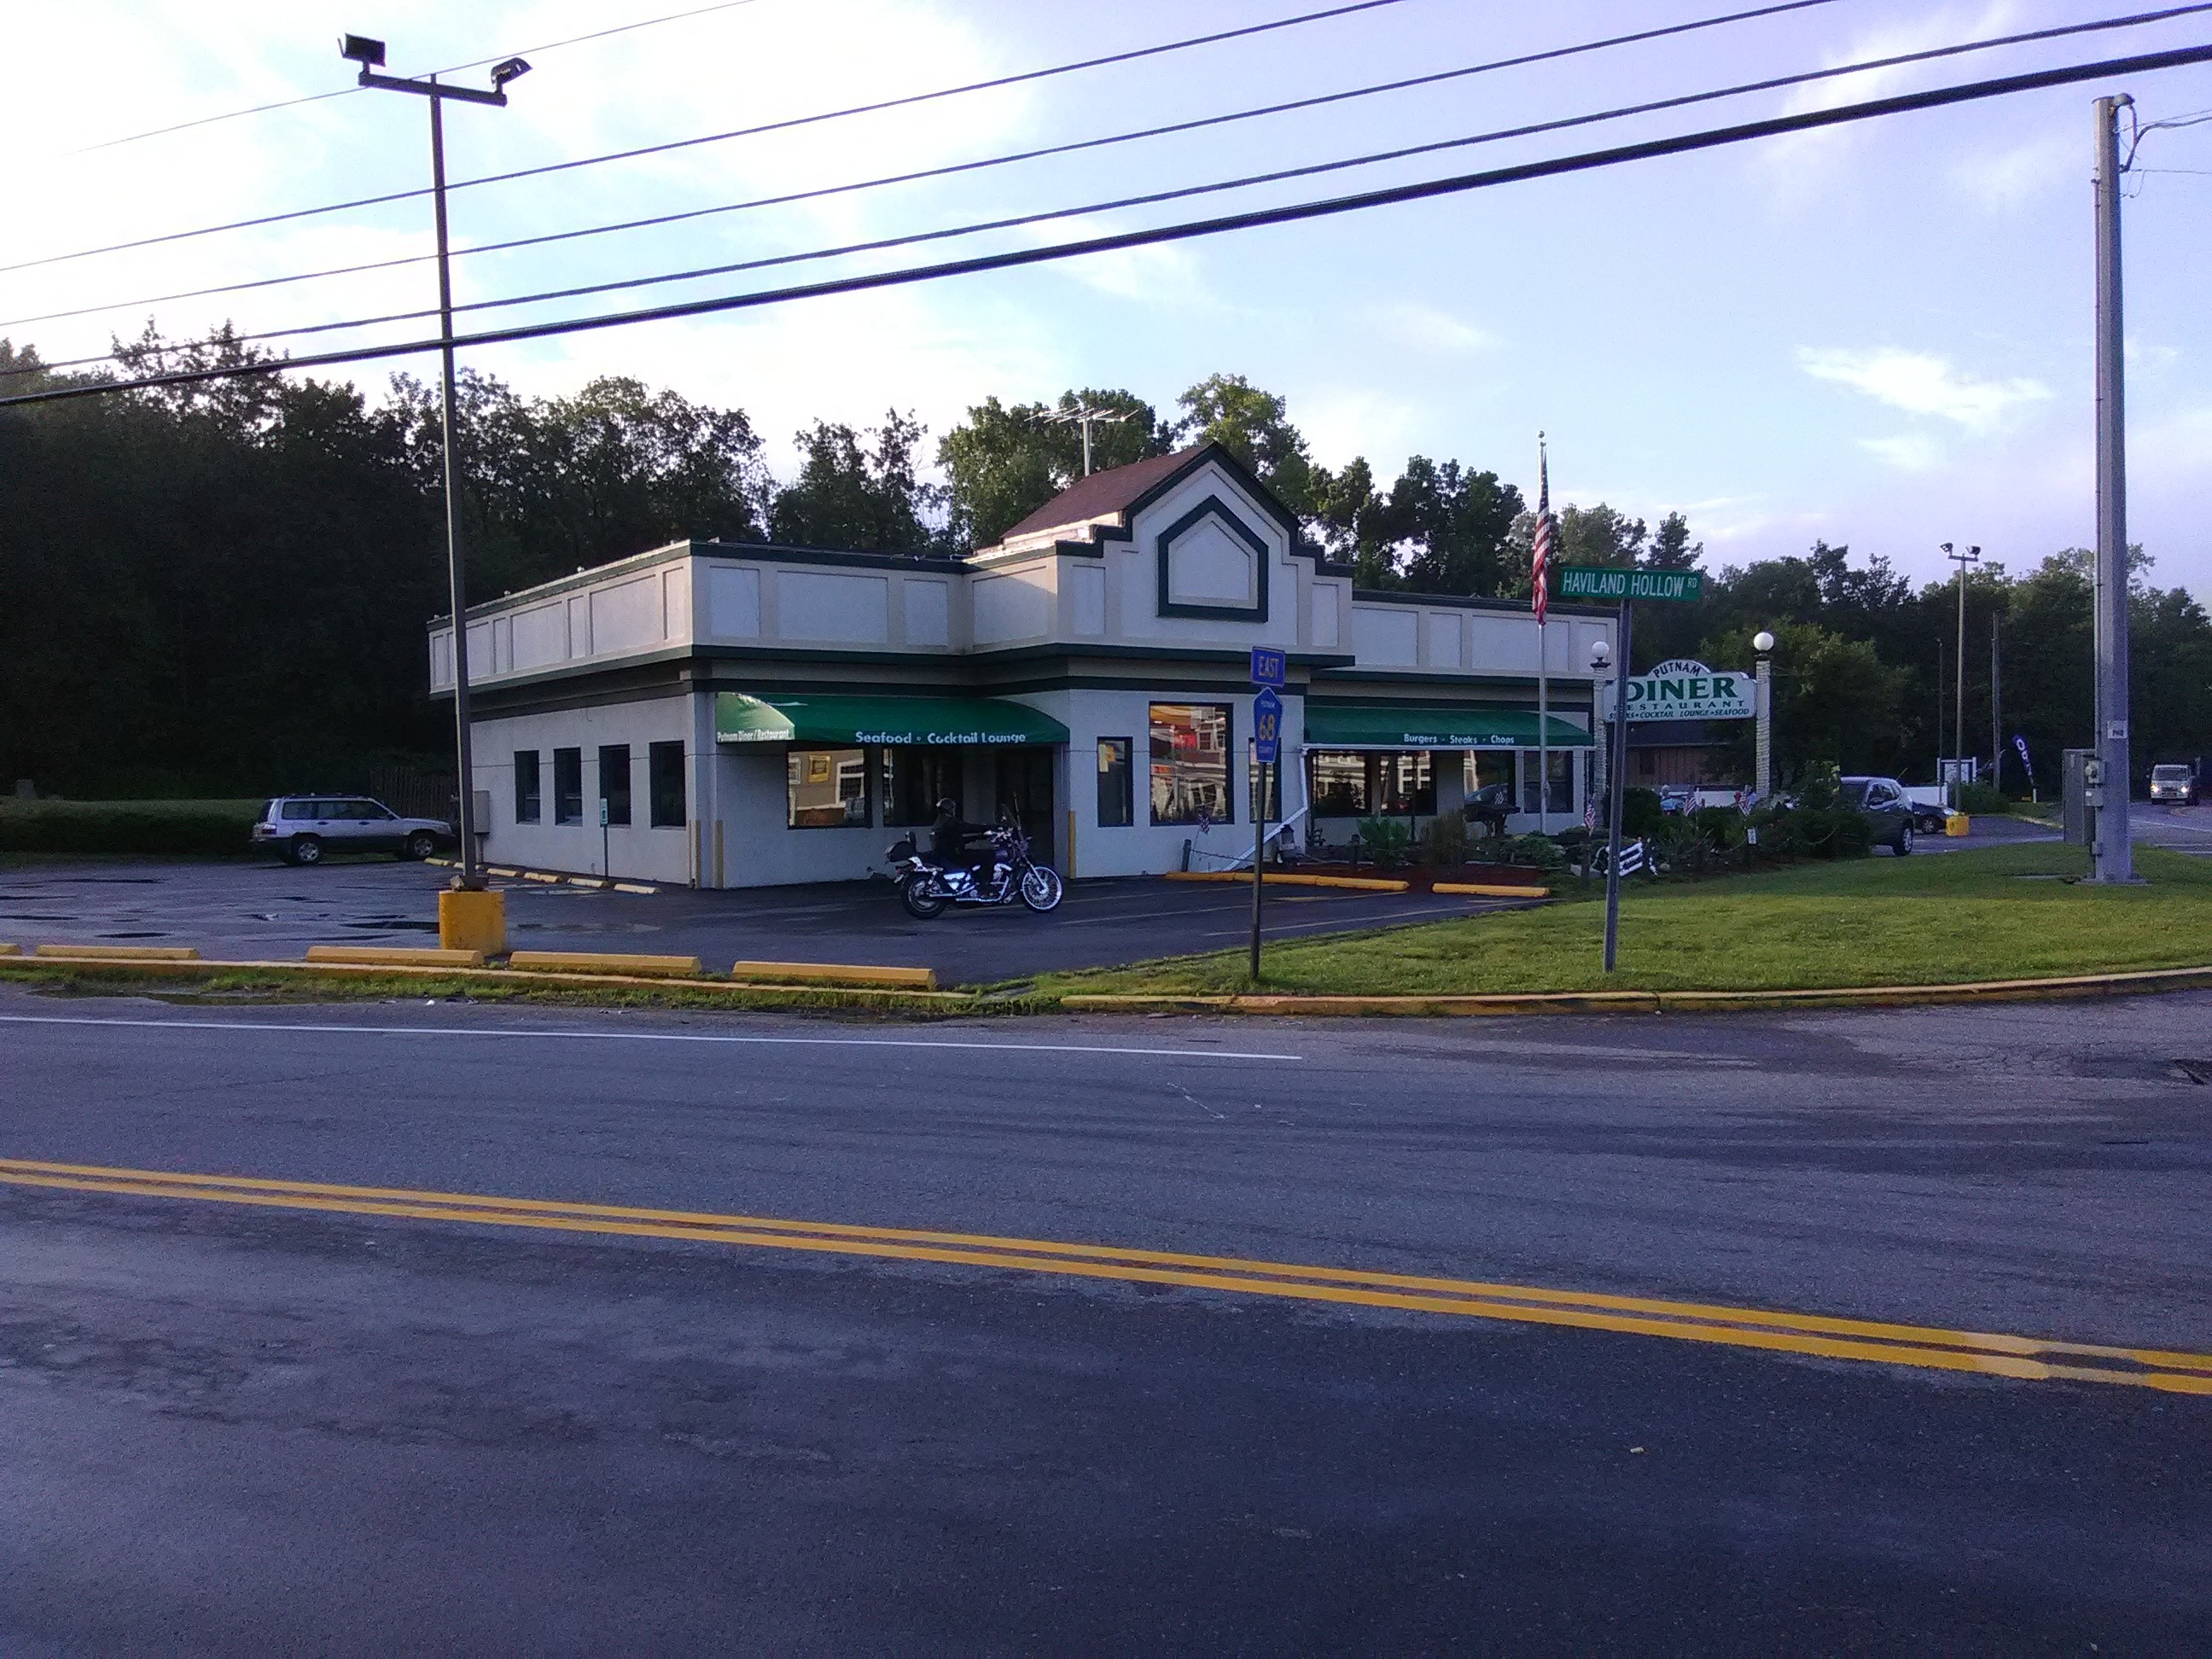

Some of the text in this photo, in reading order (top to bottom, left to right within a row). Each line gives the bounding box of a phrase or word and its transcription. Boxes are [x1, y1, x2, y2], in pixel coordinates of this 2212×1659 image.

[1563, 572, 1697, 597] HAVILAND HOLLOW RD
[1258, 655, 1279, 678] EAST
[1653, 661, 1701, 678] PUTNAM
[1613, 700, 1745, 711] ESTAURANT
[1639, 710, 1674, 719] COCKTAIL
[1679, 708, 1708, 717] LOUNGE
[1714, 707, 1749, 716] SEAFOOD
[1259, 713, 1275, 742] 68
[855, 731, 1027, 744] Seafood Cocktail Lounge
[1404, 733, 1515, 744] Burgers Steaks Chops
